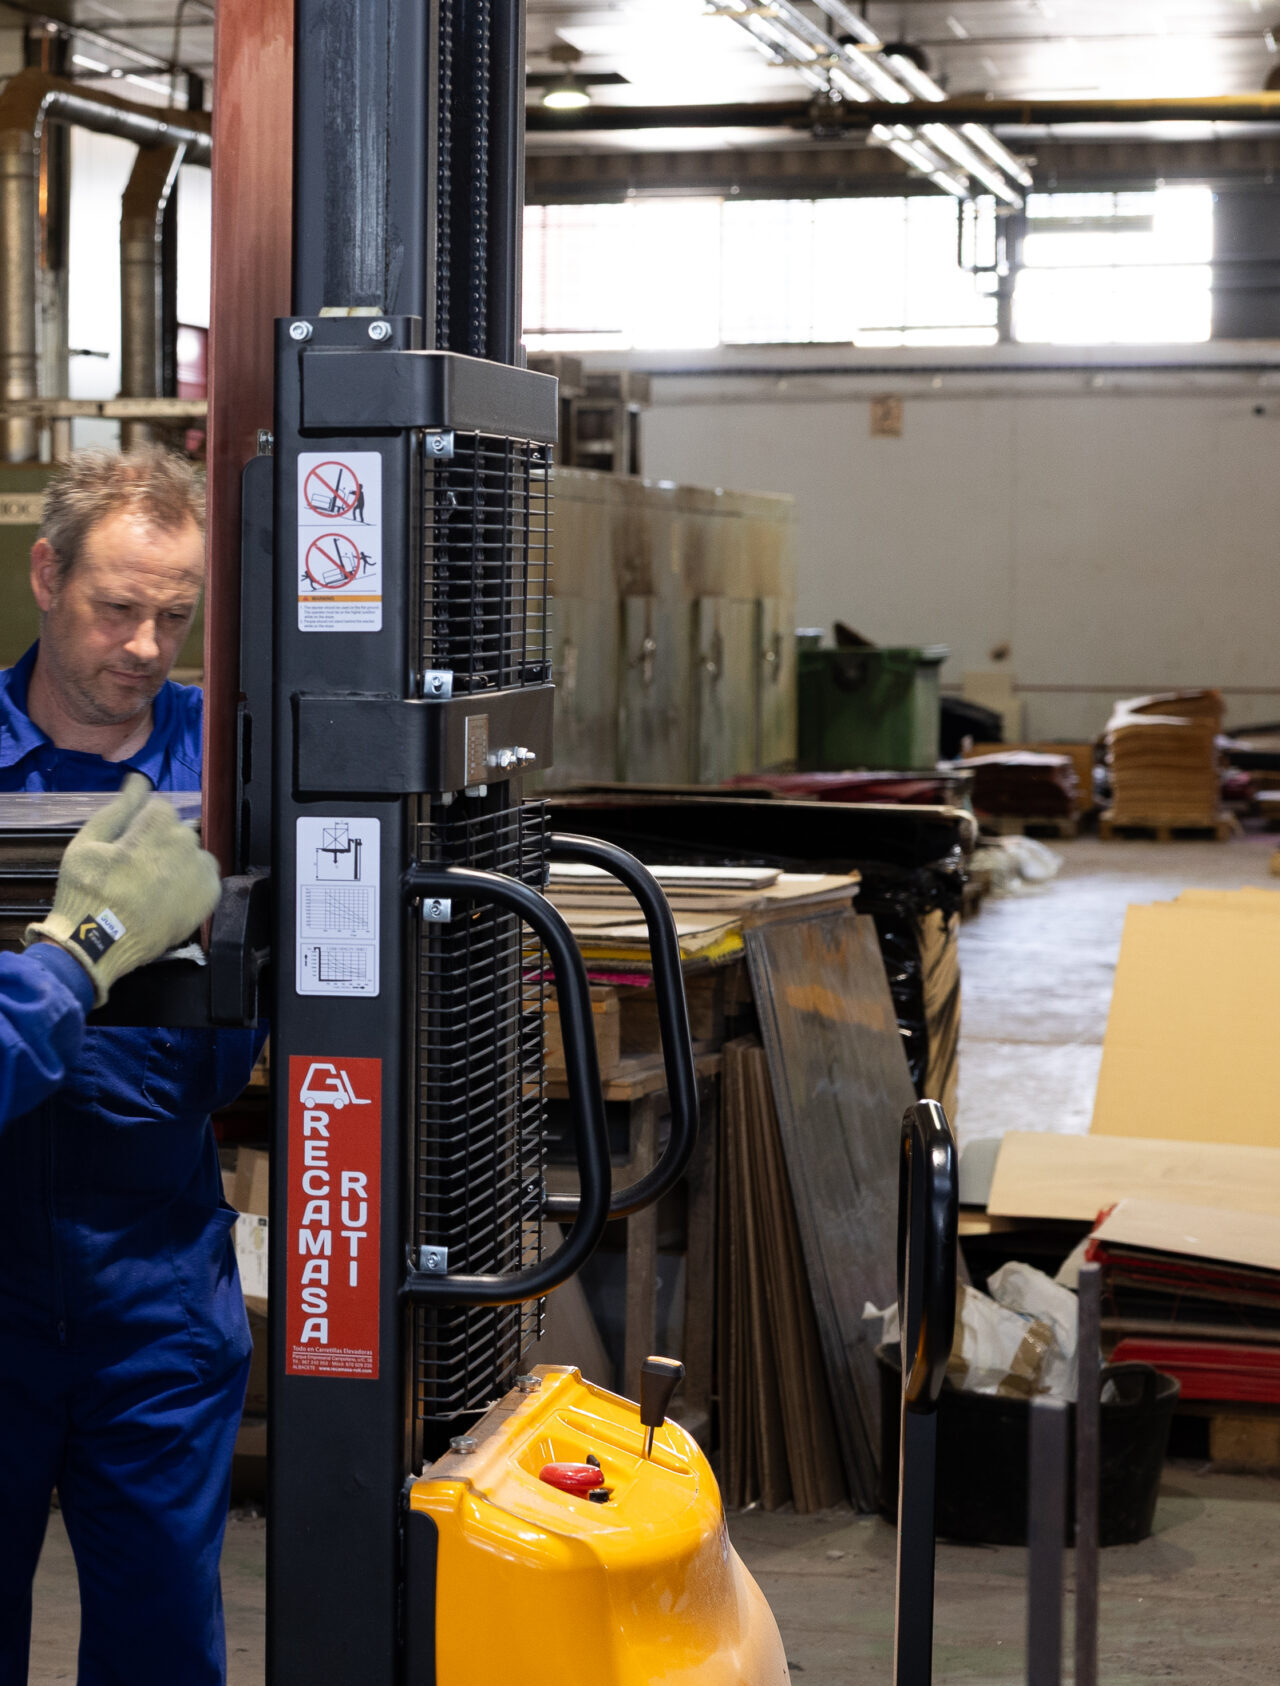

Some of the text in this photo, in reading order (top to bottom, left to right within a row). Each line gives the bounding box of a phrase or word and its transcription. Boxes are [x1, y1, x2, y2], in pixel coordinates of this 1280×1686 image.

[298, 1109, 331, 1344] RECAMASA
[340, 1170, 368, 1287] RUTI
[315, 1346, 342, 1354] Carretillas
[343, 1347, 372, 1355] Elevadoras
